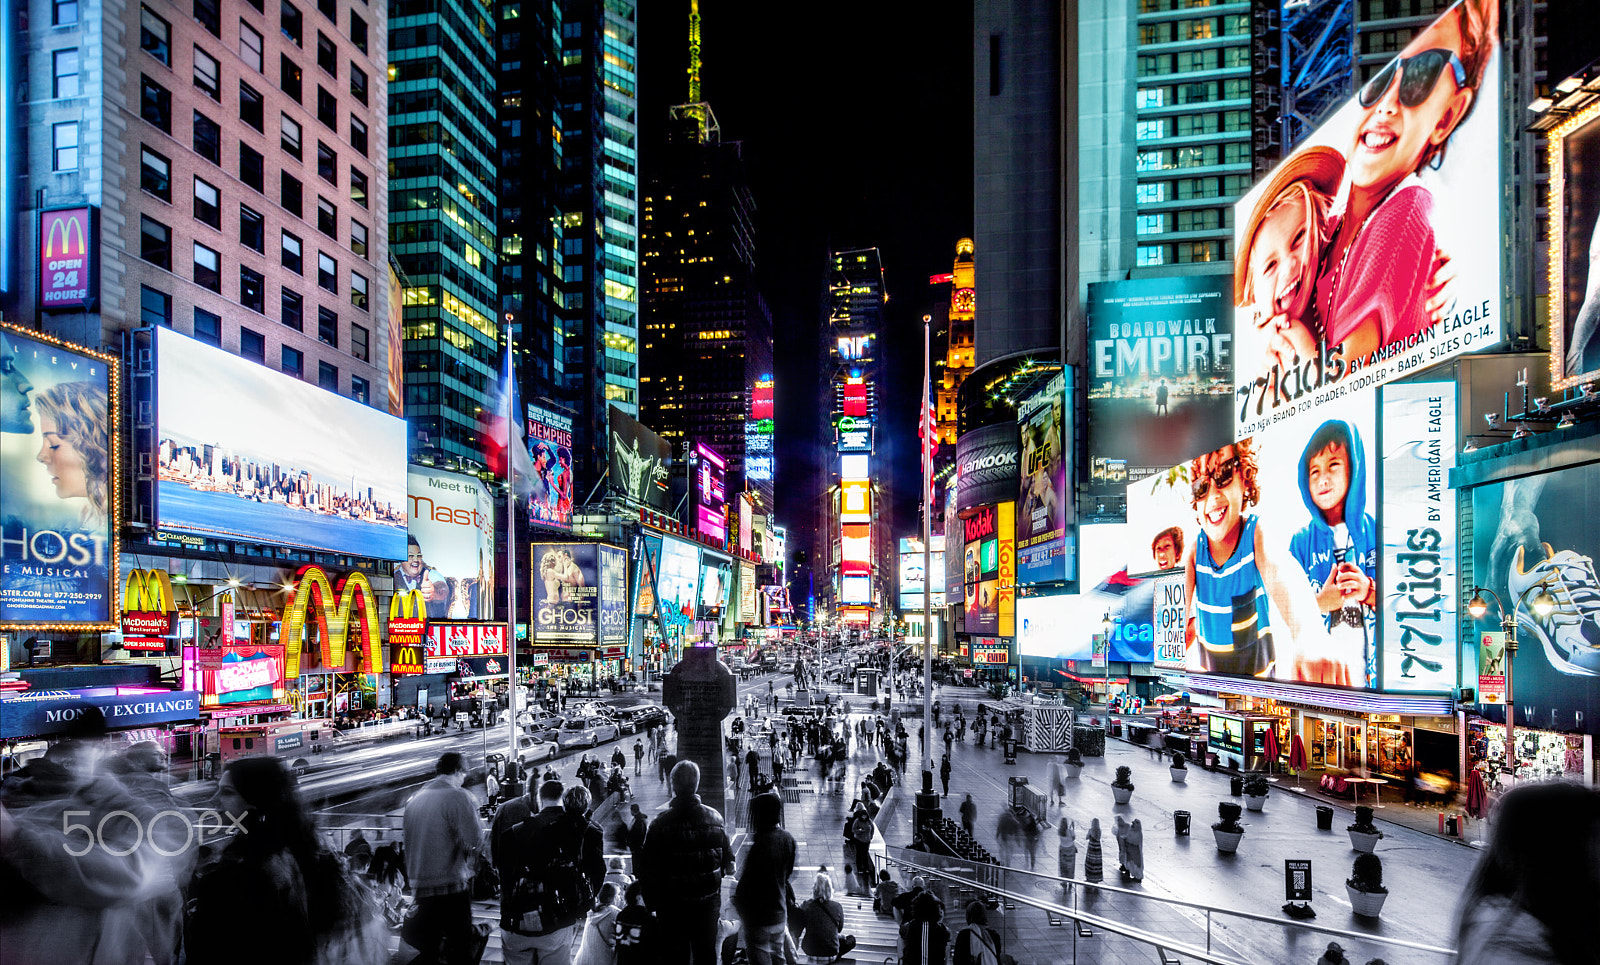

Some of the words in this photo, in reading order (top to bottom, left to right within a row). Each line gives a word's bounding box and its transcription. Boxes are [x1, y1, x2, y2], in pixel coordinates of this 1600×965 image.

[48, 258, 82, 271] OPEN
[52, 272, 78, 288] 24
[44, 289, 86, 301] HOURS
[1109, 317, 1216, 338] BOARDWALK
[1350, 358, 1364, 375] BY
[1369, 324, 1436, 366] AMERICAN
[1443, 300, 1491, 334] EAGLE
[1094, 333, 1232, 378] EMPIRE
[1273, 406, 1296, 424] BRAND
[1298, 399, 1312, 413] FOR
[1349, 369, 1387, 393] TODDLER
[1429, 337, 1460, 360] SIZES
[528, 411, 545, 422] BEST
[546, 417, 573, 432] MUSICAL
[1429, 395, 1442, 434] EAGLE
[529, 420, 572, 447] MEMPHIS
[1027, 441, 1051, 477] UFC
[1428, 442, 1441, 502] AMERICAN
[428, 477, 460, 492] Meet
[1428, 503, 1441, 521] BY
[965, 508, 993, 542] Kodak
[0, 525, 108, 567] HOST
[22, 567, 89, 579] MUSICAL
[999, 538, 1014, 603] Kodak
[54, 592, 102, 600] 877-250-2929
[123, 617, 168, 627] McDonald's
[538, 607, 595, 625] GHOST
[601, 608, 626, 626] GHOST
[1162, 606, 1185, 629] OPE
[986, 652, 1007, 663] EVITA
[1164, 644, 1186, 660] LEVEL
[45, 704, 109, 723] MONY
[112, 699, 194, 718] EXCHANGE
